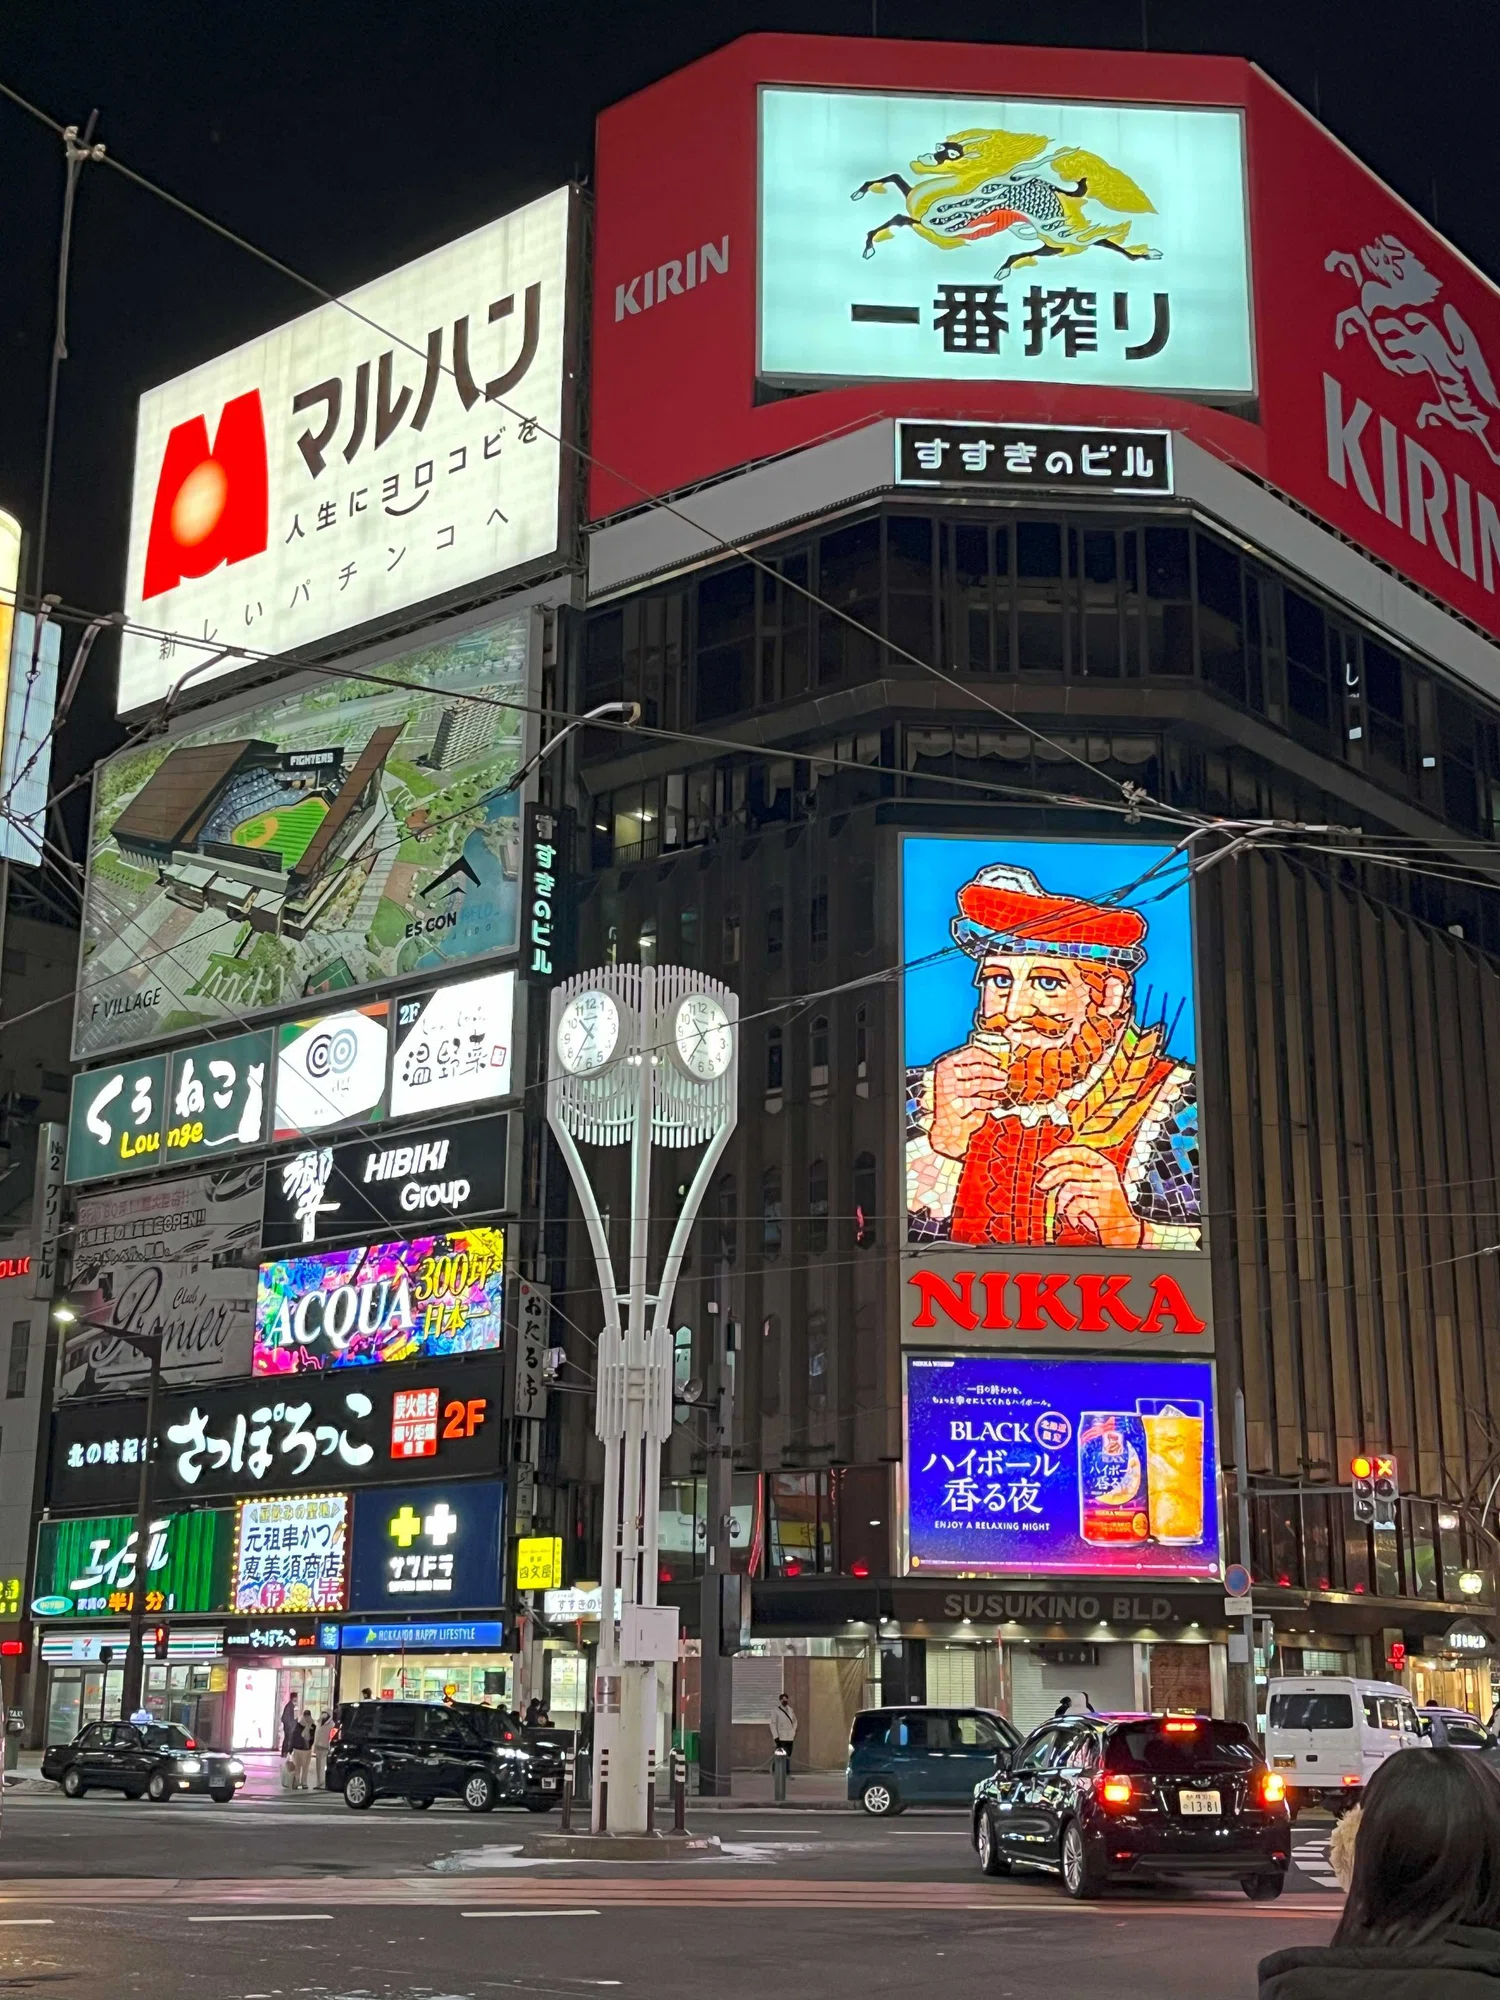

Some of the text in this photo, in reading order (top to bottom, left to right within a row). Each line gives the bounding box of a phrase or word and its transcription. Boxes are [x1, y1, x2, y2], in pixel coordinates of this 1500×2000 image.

[614, 236, 730, 322] KIRIN
[851, 284, 1171, 360] 一番搾り
[293, 281, 542, 479] マルハン
[912, 436, 1154, 478] すすきのビル
[285, 416, 540, 544] 人生にヨロコビを
[158, 507, 509, 662] 新しいパチンコへ
[289, 752, 334, 766] FIGHTERS
[531, 813, 557, 975] すすきのビル
[91, 987, 162, 1021] F VILLAGE
[399, 1002, 421, 1025] 2F
[564, 1033, 571, 1044] 9
[677, 1025, 684, 1036] 9
[720, 1038, 726, 1050] 3
[567, 1047, 574, 1059] 8
[597, 1051, 604, 1062] 5
[698, 1061, 704, 1073] 6
[708, 1060, 715, 1072] 5
[86, 1058, 238, 1146] くろねこ
[119, 1121, 204, 1159] Lounge
[50, 1156, 61, 1171] 2
[363, 1139, 450, 1184] HIBIKI
[401, 1179, 471, 1212] Group
[414, 1254, 495, 1302] 300坪
[267, 1276, 415, 1349] ACQUA
[907, 1270, 1207, 1334] NIKKA
[424, 1303, 491, 1339] 日本一
[932, 1395, 1052, 1408] ちょっと幸せにしてくれるハイボール。
[966, 1385, 1023, 1396] 一日の終わりを、
[443, 1399, 487, 1438] 2F
[950, 1420, 1033, 1443] BLACK
[167, 1393, 375, 1484] さっぽろっこ
[921, 1448, 1061, 1478] ハイボール
[940, 1476, 1044, 1514] 香る夜
[244, 1523, 331, 1553] 元祖串かつ
[934, 1520, 1051, 1531] ENJOY A RELAXING NIGHT
[242, 1551, 341, 1582] 恵美須商店
[265, 1591, 280, 1607] 1F
[557, 1599, 617, 1611] すすきの
[944, 1594, 1179, 1622] SUSUKINO BLD.
[378, 1627, 476, 1641] HOKKAIDO HAPPY LIFESTYLE
